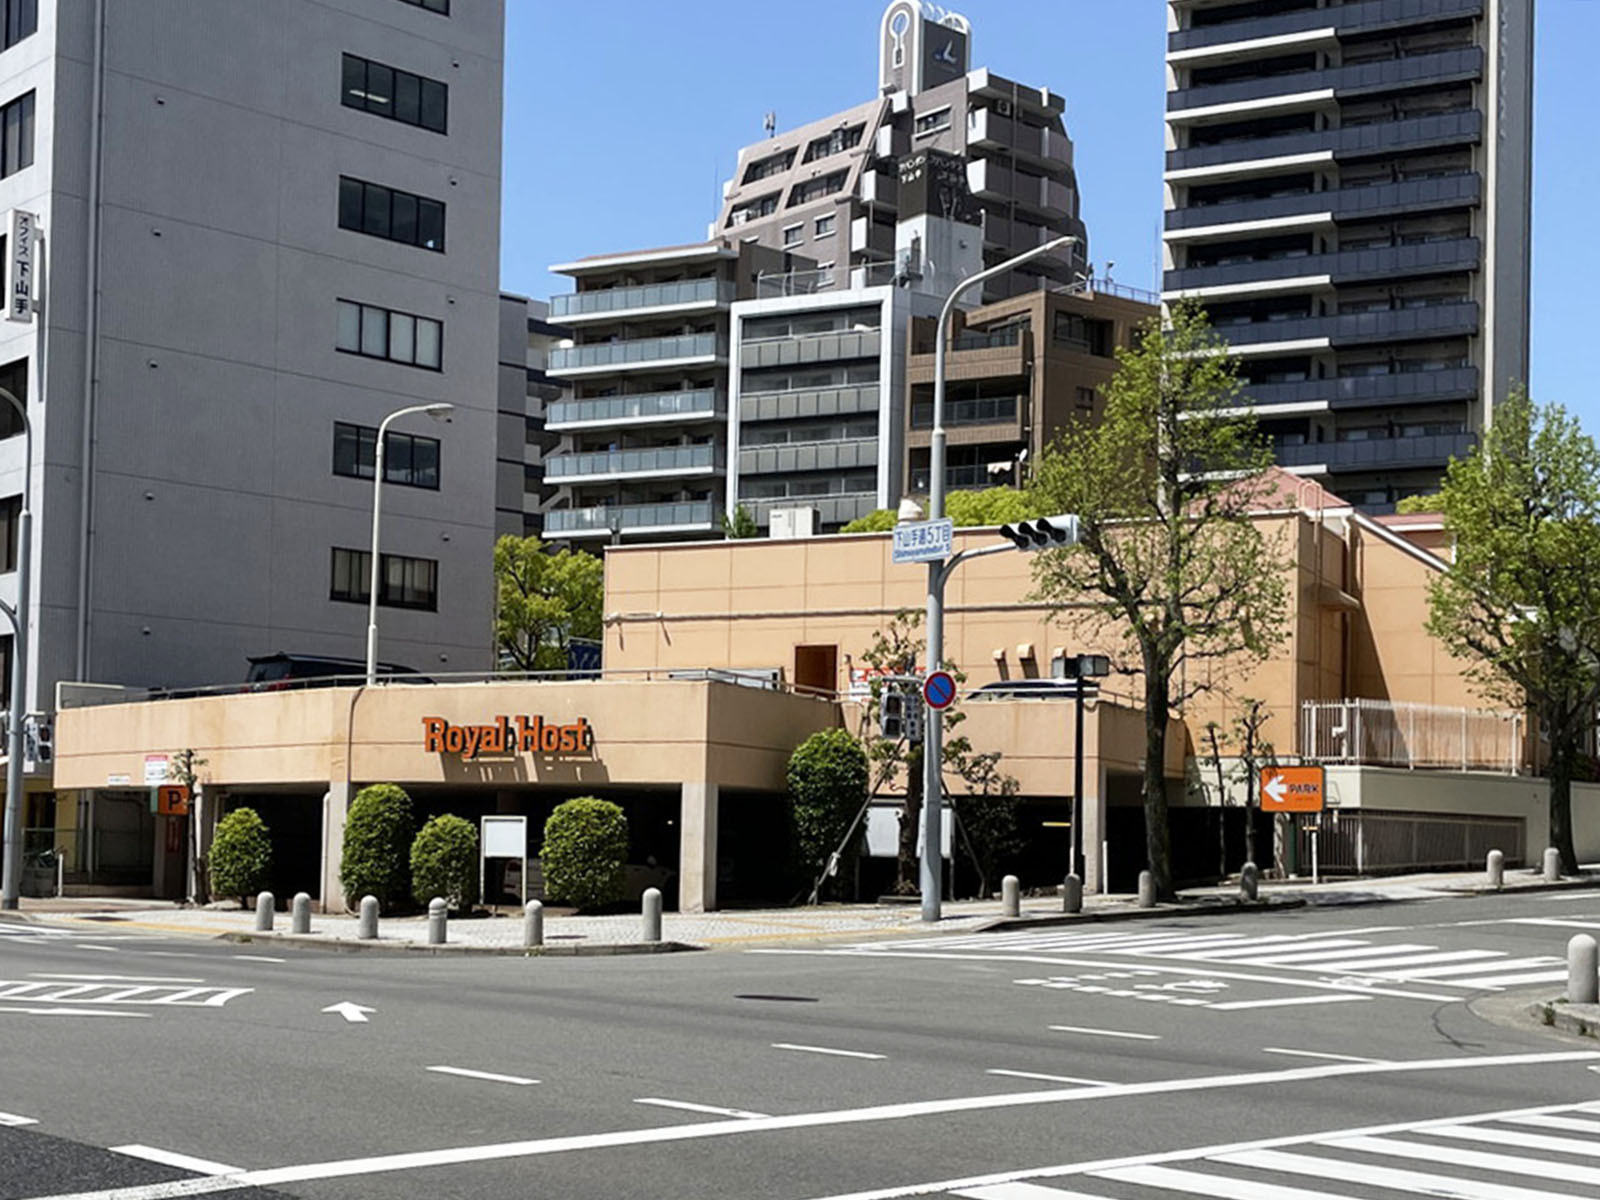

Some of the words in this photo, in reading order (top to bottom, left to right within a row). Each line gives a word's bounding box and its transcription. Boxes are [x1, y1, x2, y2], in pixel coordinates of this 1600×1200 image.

[422, 715, 508, 759] Royal
[515, 715, 590, 752] Host
[167, 789, 182, 811] P
[1289, 784, 1319, 794] PARK
